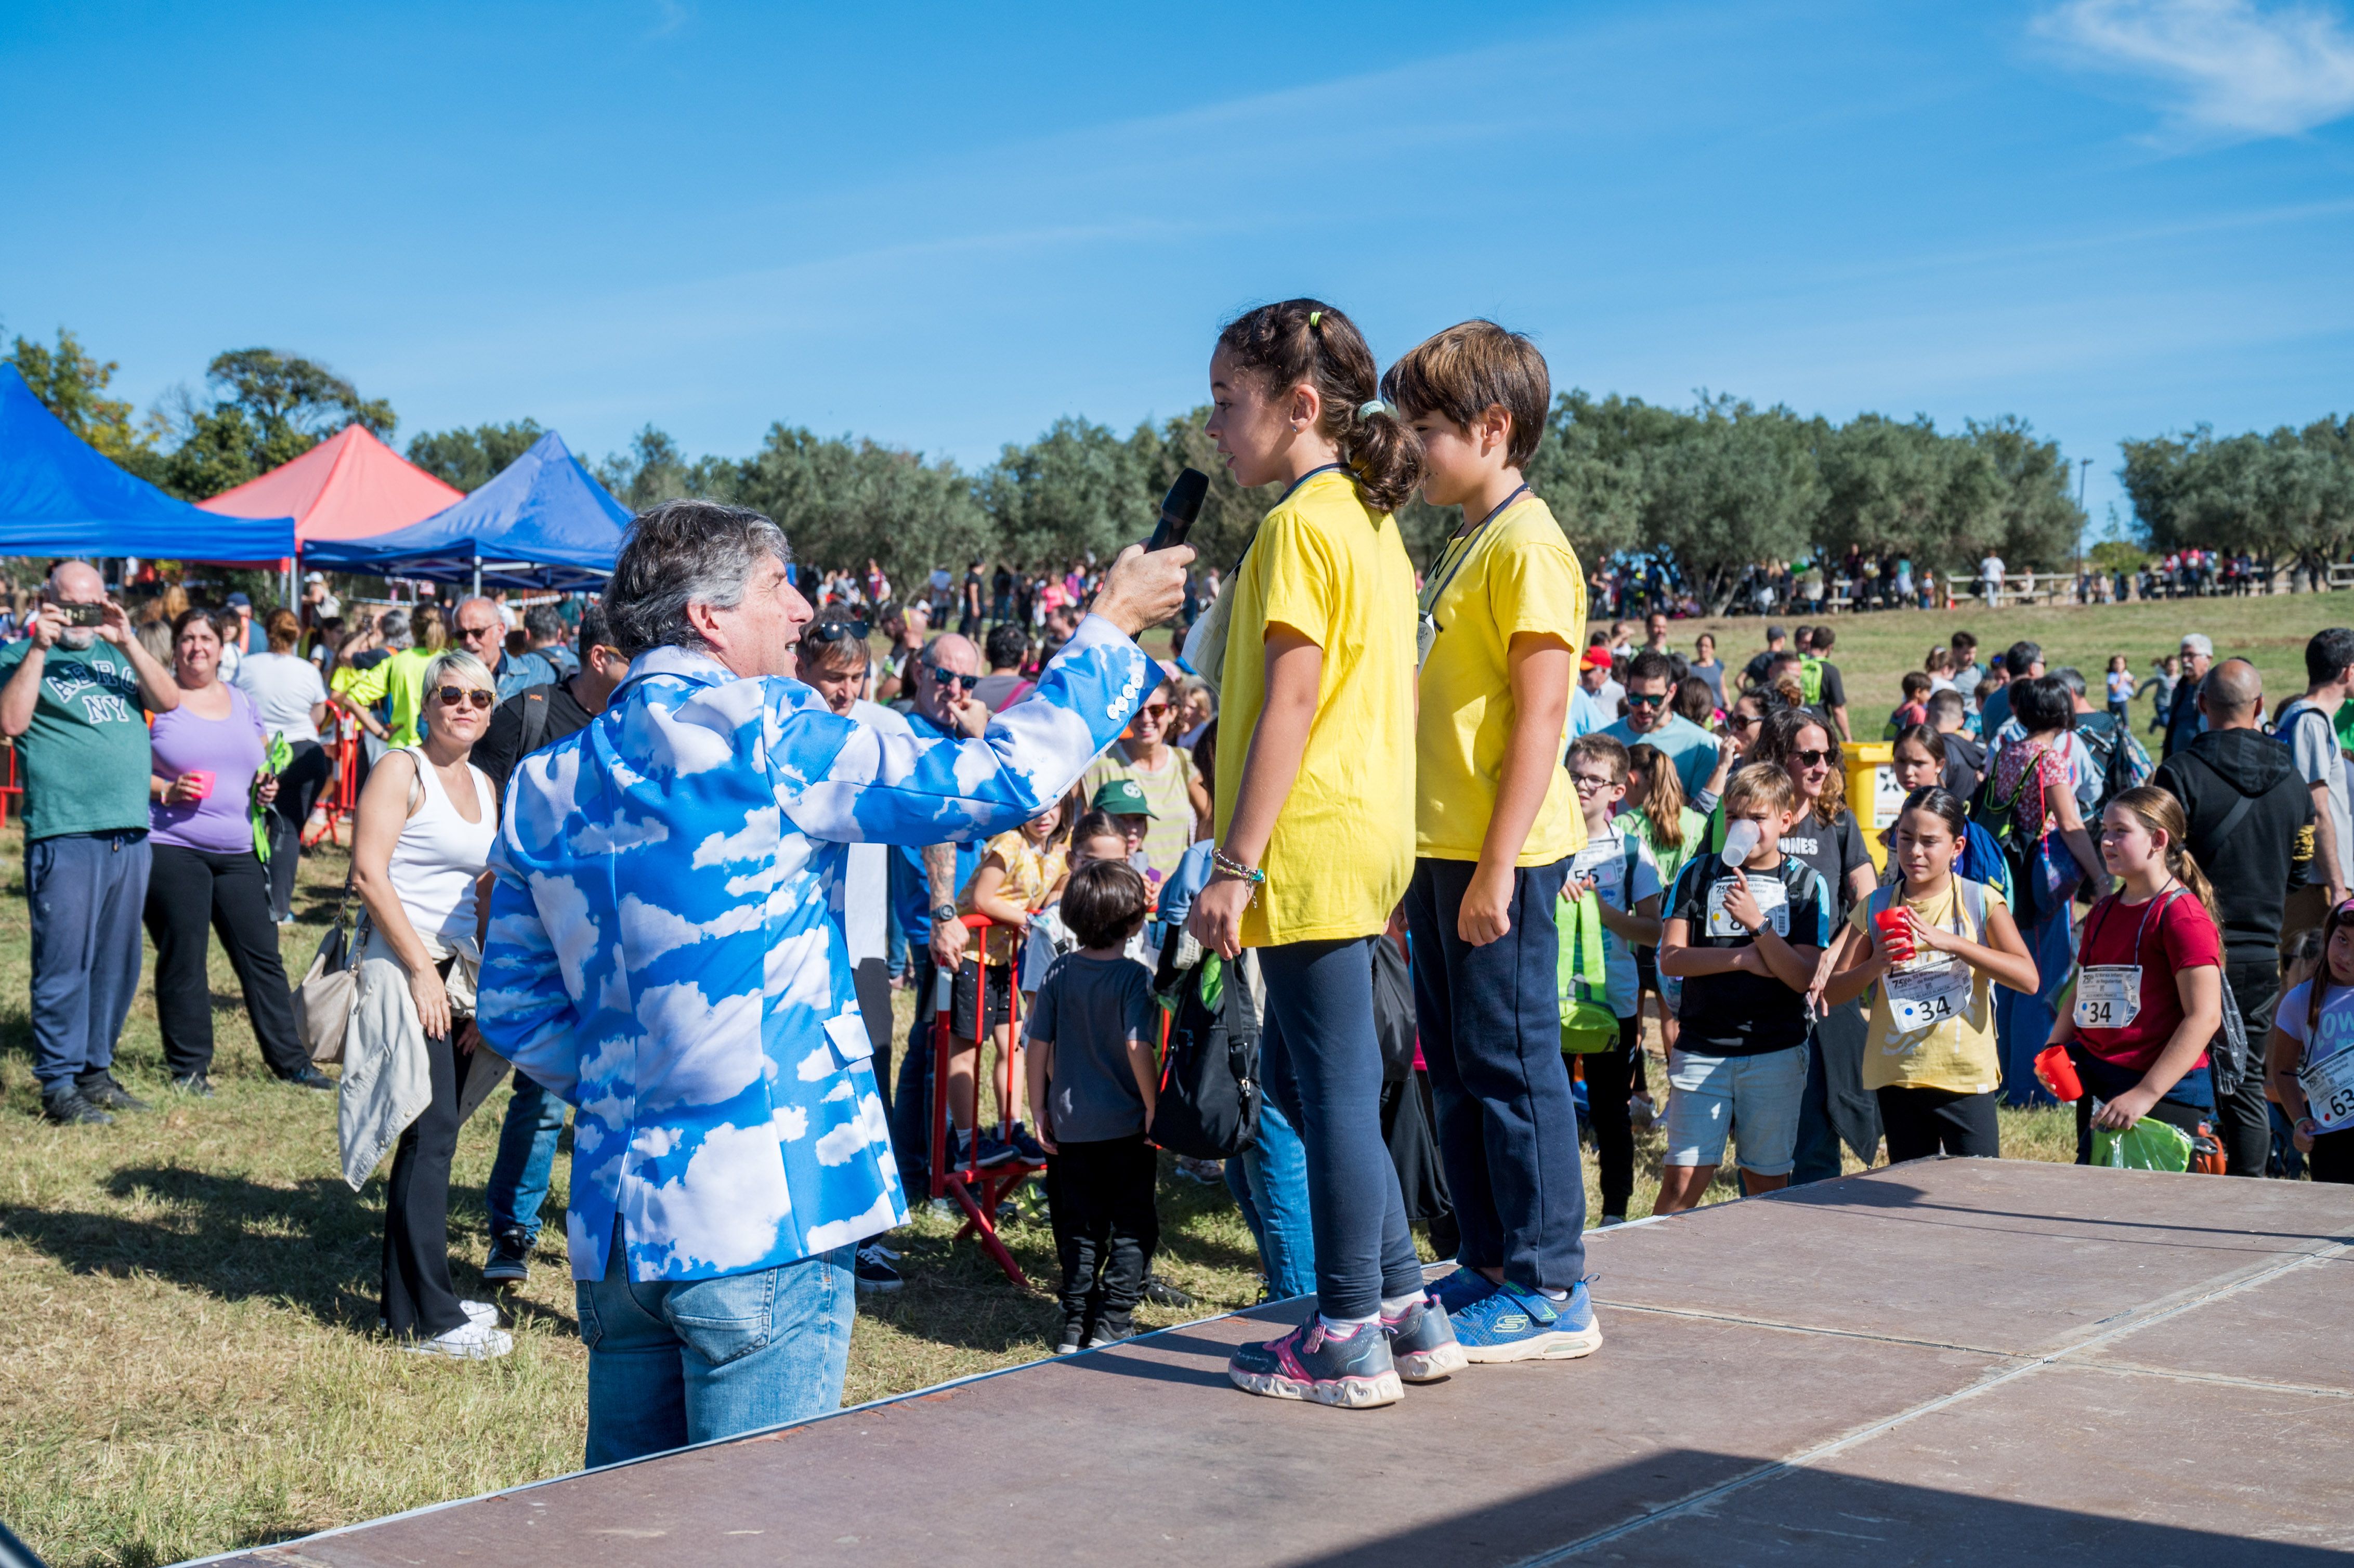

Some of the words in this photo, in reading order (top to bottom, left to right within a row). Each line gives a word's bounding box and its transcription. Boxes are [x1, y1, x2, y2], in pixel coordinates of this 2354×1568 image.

[82, 693, 129, 724] NY
[1776, 837, 1819, 856] ONES
[1924, 972, 1949, 982] Regularitat
[1919, 996, 1951, 1021] 34
[2089, 1002, 2112, 1023] 34
[2330, 1089, 2354, 1116] 63
